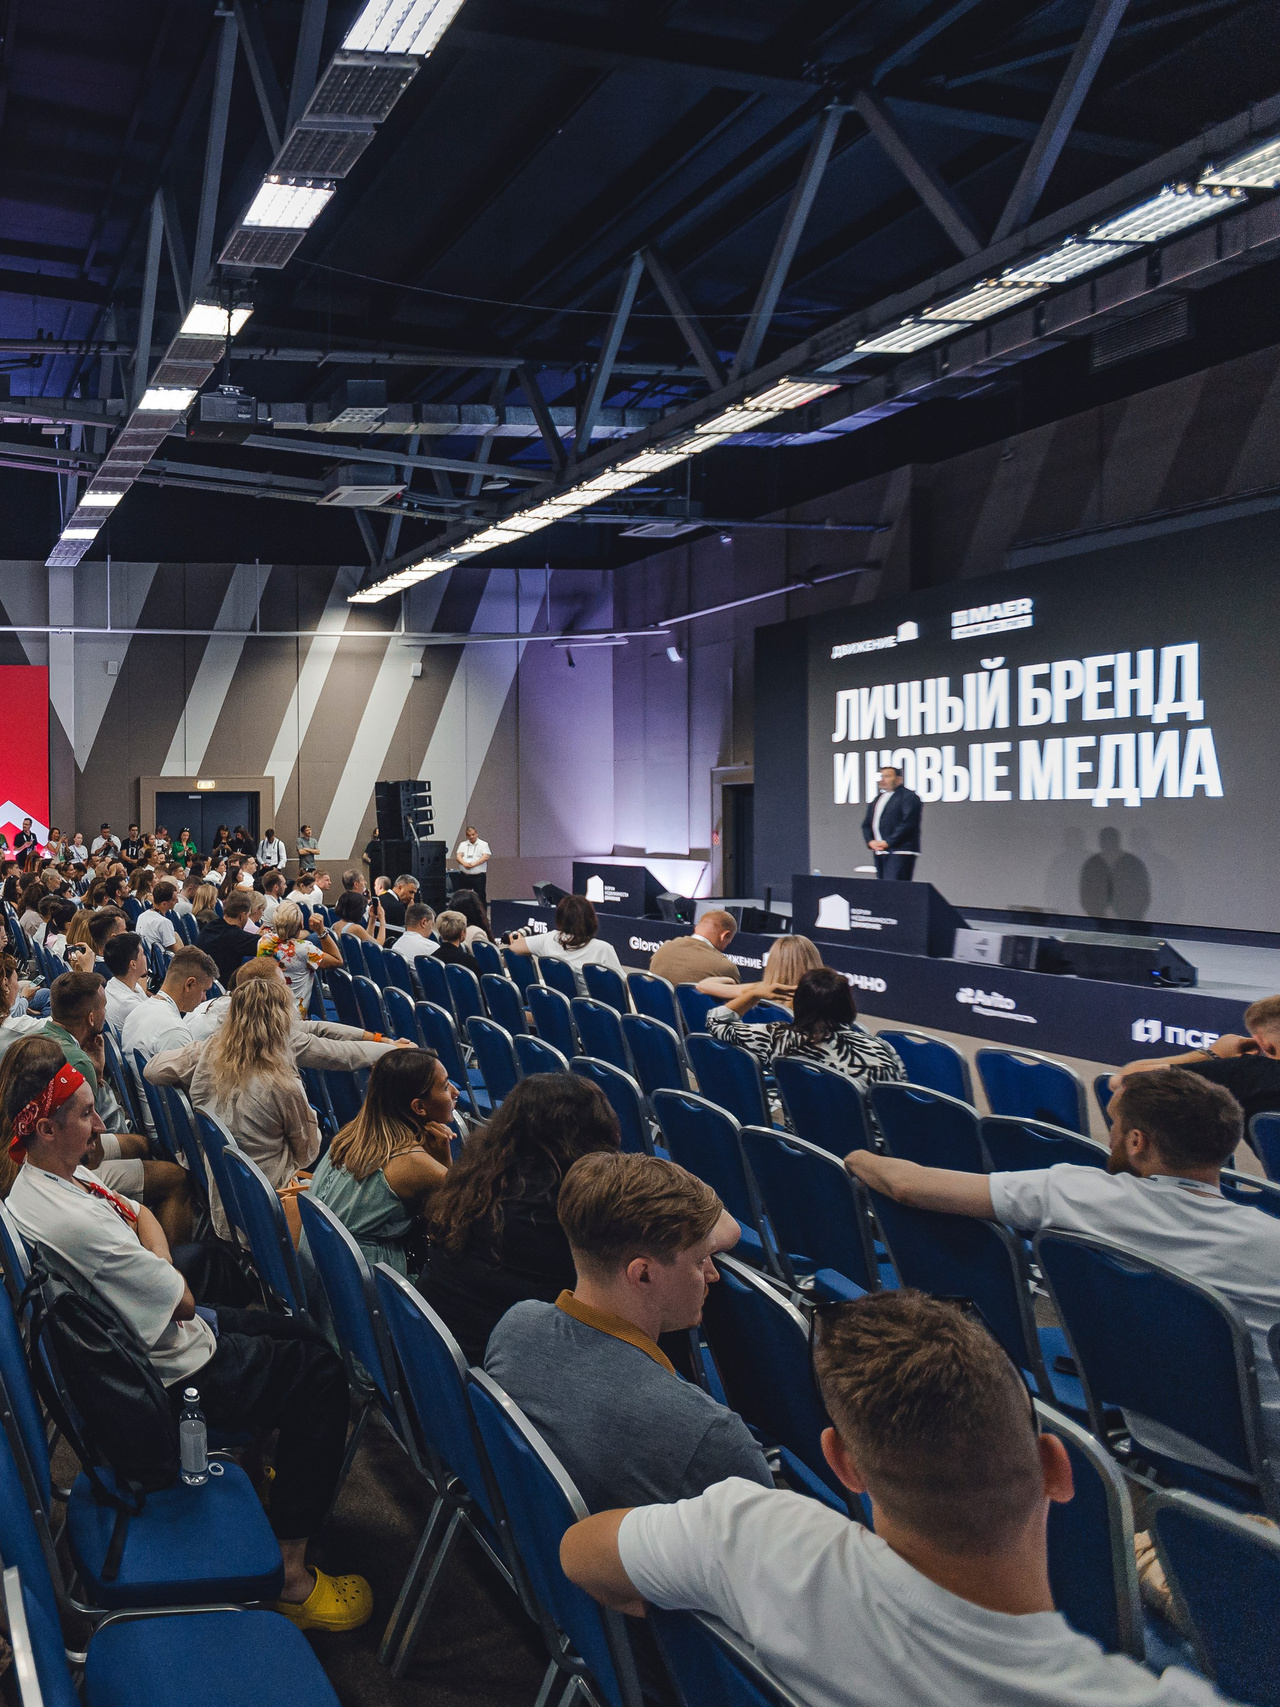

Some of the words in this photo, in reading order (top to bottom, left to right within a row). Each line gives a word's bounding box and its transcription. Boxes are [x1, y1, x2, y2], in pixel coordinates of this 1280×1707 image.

[831, 656, 1010, 742] ЛИЧНЫЙ
[1018, 641, 1205, 724] БРЕНД
[833, 752, 860, 805] И
[1019, 727, 1224, 808] МЕДИА
[533, 921, 548, 934] ВТБ
[629, 936, 663, 953] Glora
